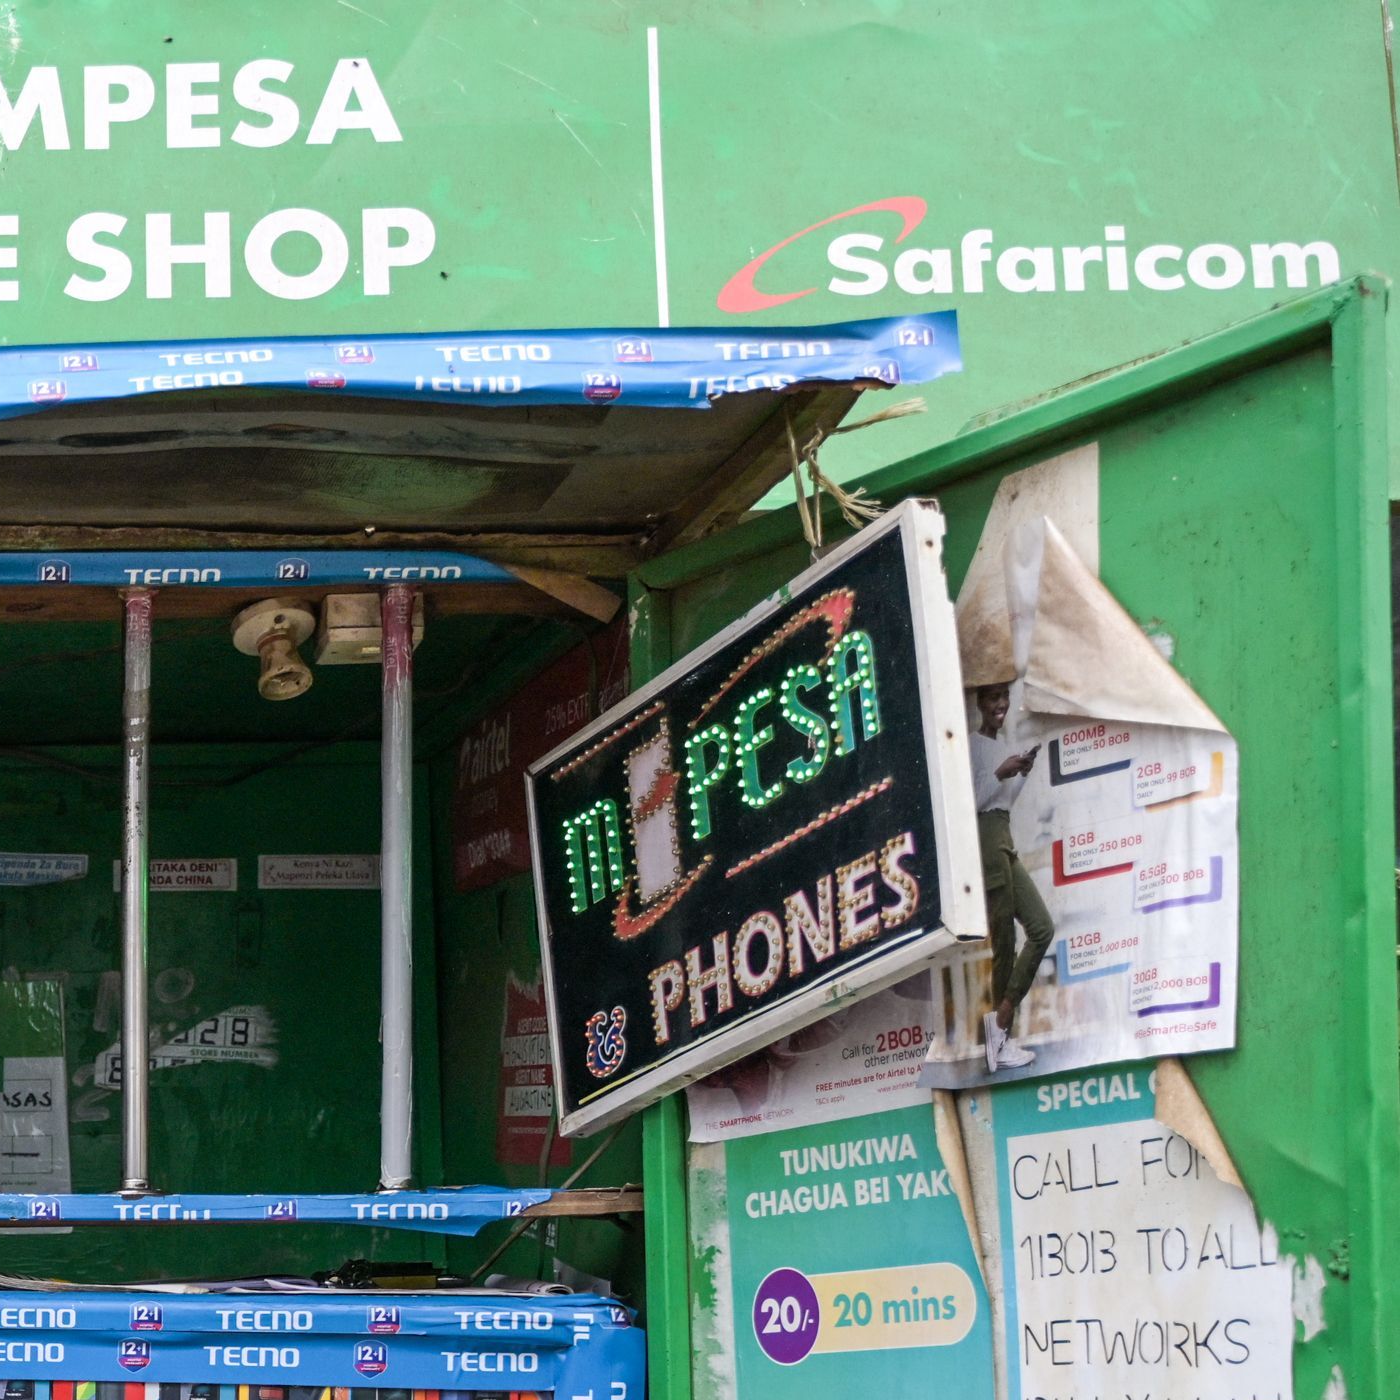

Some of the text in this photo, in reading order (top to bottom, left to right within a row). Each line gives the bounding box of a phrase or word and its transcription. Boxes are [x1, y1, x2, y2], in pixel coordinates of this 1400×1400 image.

[64, 206, 436, 302] SHOP
[826, 225, 1340, 296] Safaricom
[436, 344, 550, 362] TECNO
[1063, 724, 1106, 745] 600MB
[1093, 732, 1130, 750] 50 BOB
[1137, 762, 1161, 778] 2GB
[1069, 831, 1095, 848] 3GB
[1099, 835, 1143, 853] 250 BOB
[178, 875, 214, 886] CHINA
[648, 832, 919, 1045] PHONES
[1069, 932, 1101, 949] 12GB
[1121, 937, 1139, 948] BOB
[1133, 968, 1157, 985] 30GB
[1186, 976, 1208, 987] BOB
[841, 1048, 860, 1061] Call
[861, 1043, 875, 1056] for
[864, 1055, 889, 1069] other
[816, 1067, 906, 1092] FREE minutes are for Airtel
[1037, 1073, 1141, 1112] SPECIAL
[719, 1113, 762, 1129] SMARTPHONE
[780, 1133, 917, 1176] TUNUKIWA
[1013, 1143, 1118, 1200] CALL
[745, 1182, 849, 1219] CHAGUA
[854, 1176, 890, 1206] BEI
[1136, 1227, 1189, 1275] TO
[1198, 1223, 1277, 1274] ALL
[832, 1292, 873, 1328] 20
[882, 1286, 957, 1324] mins
[1024, 1319, 1250, 1368] NETWORKS
[203, 1345, 300, 1367] TECNO
